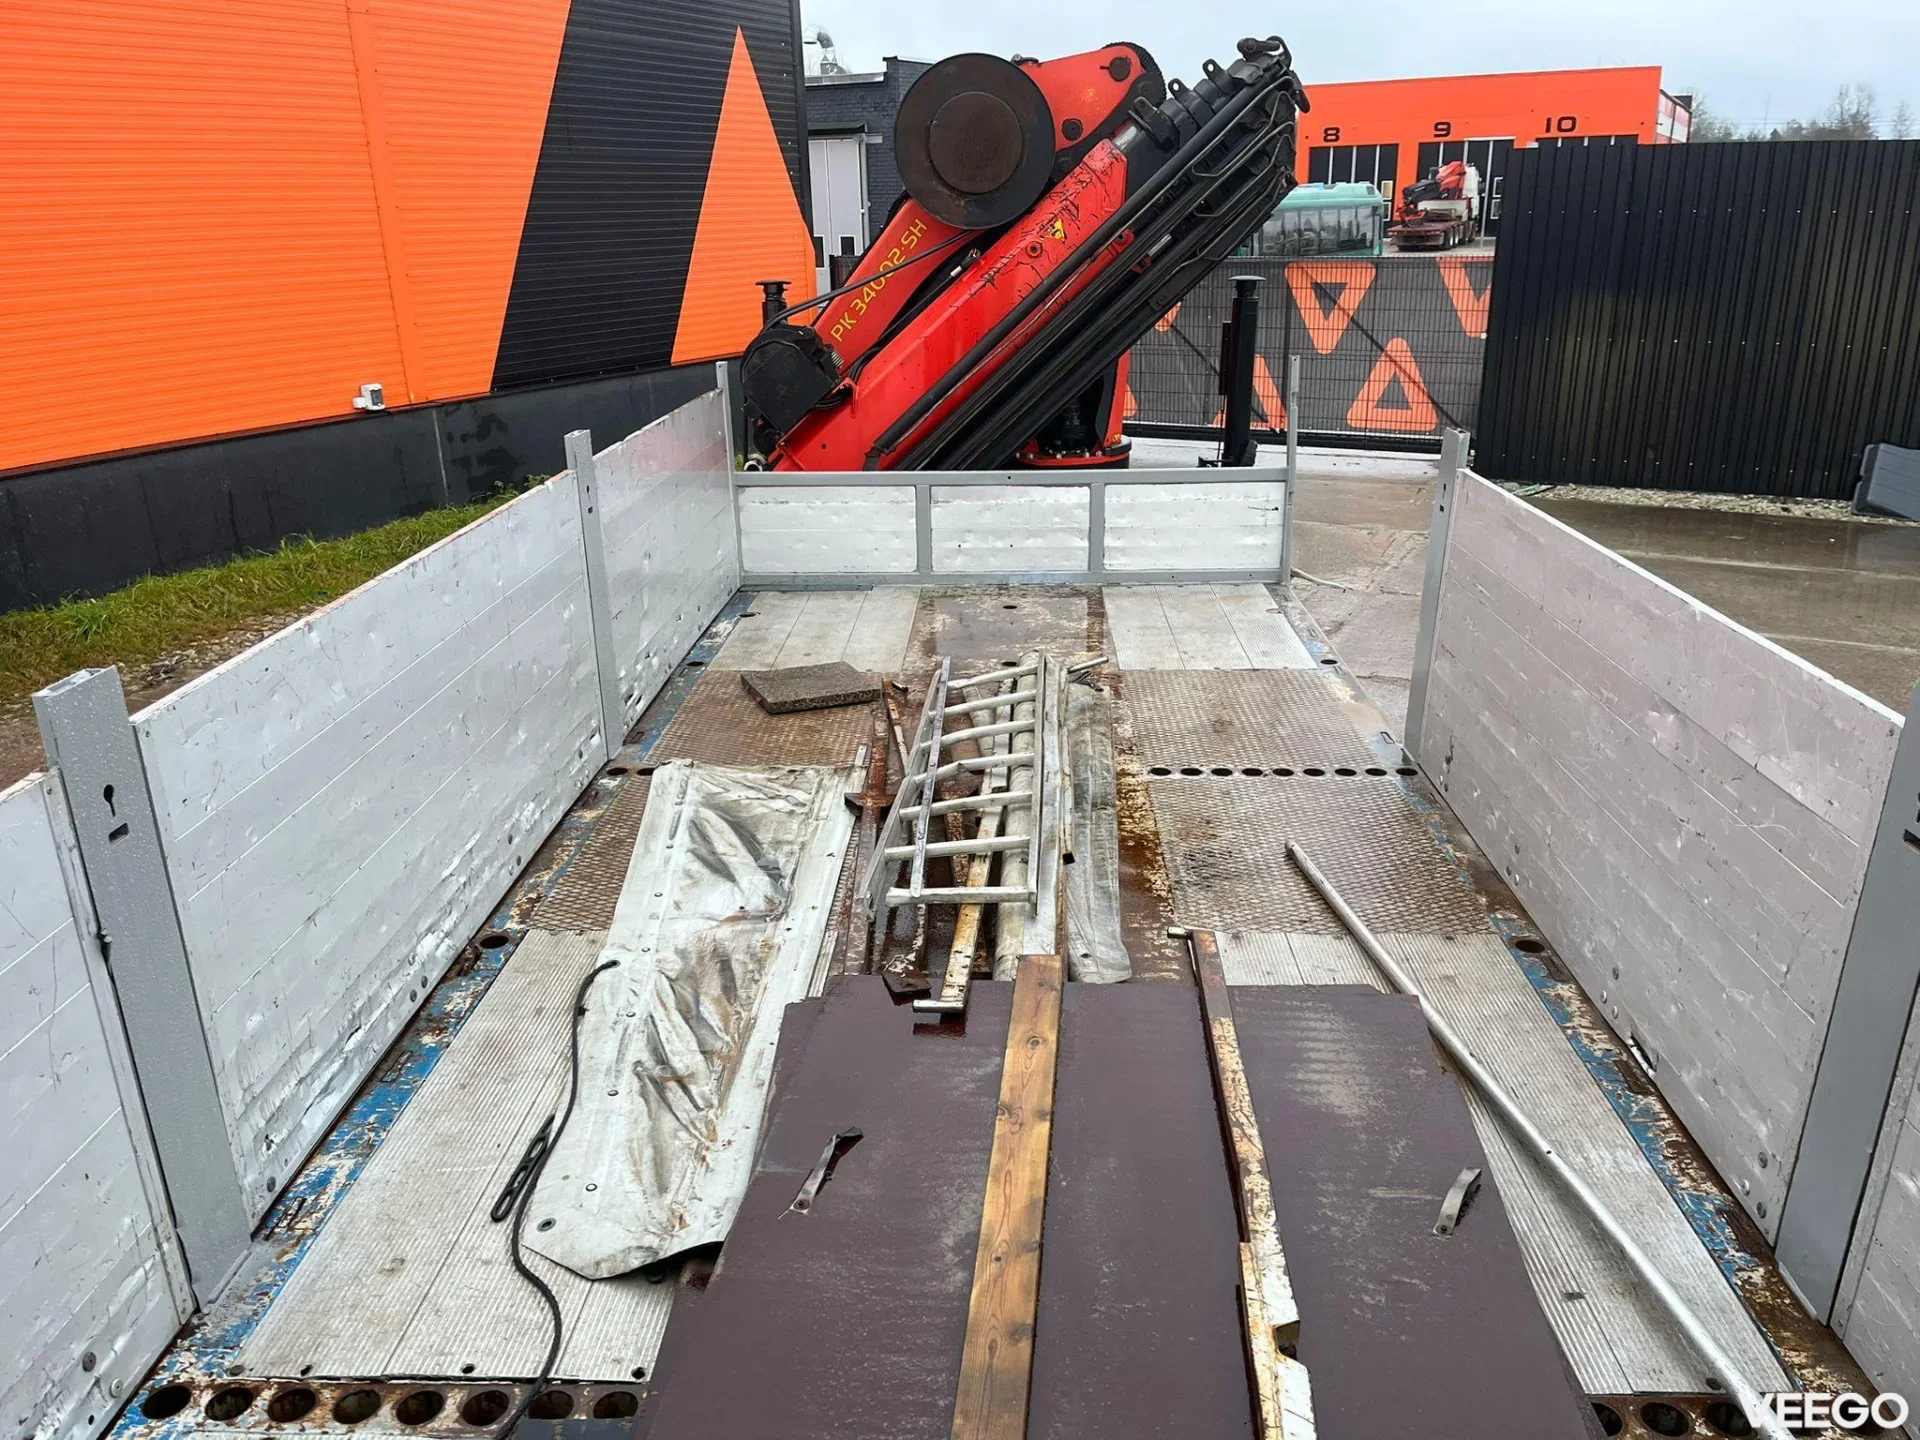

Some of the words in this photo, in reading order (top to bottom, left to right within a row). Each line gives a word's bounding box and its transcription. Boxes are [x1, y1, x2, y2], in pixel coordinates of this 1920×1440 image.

[1433, 121, 1452, 138] 9
[1545, 116, 1577, 133] 10
[1323, 127, 1341, 143] 8
[830, 311, 857, 342] PK
